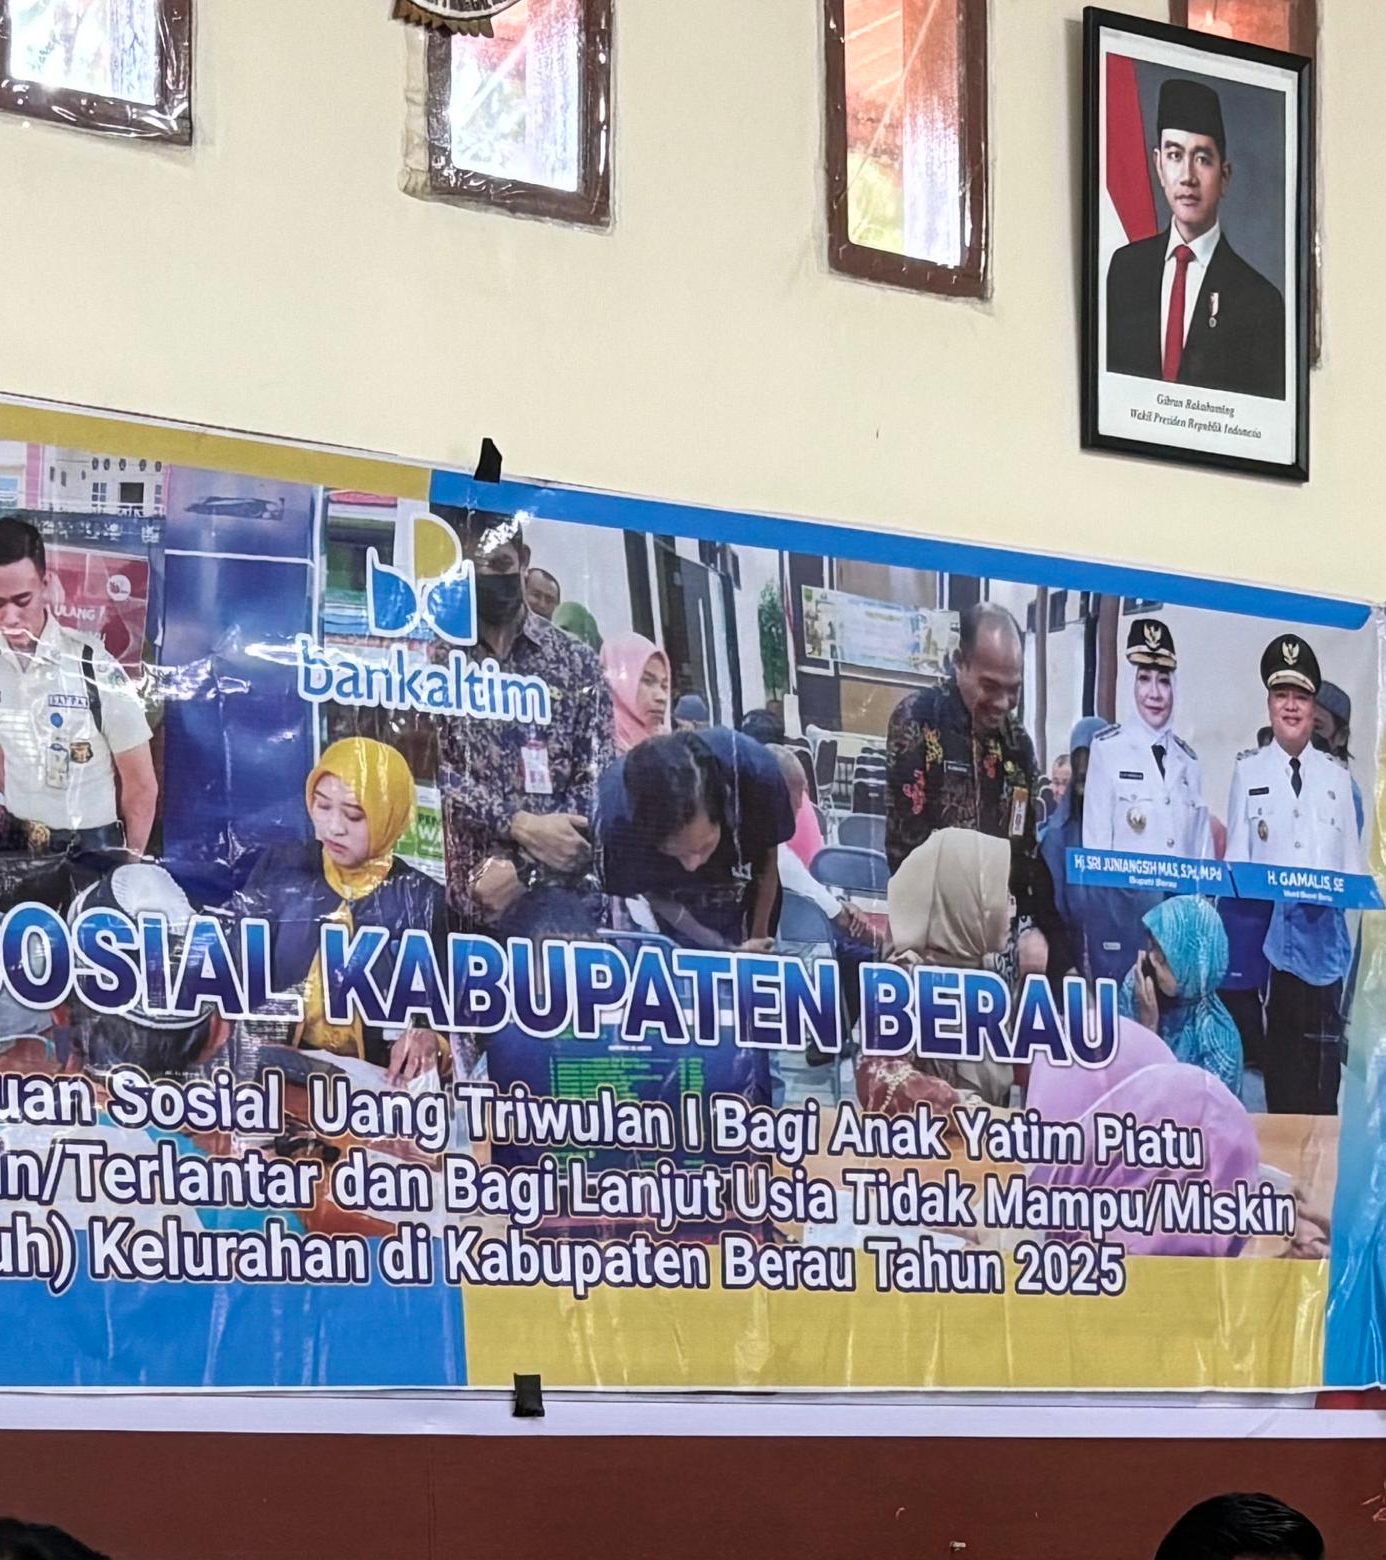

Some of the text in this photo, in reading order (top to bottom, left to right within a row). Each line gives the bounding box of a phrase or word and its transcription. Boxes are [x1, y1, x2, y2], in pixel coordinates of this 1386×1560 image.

[297, 634, 550, 723] bankaltim
[320, 922, 842, 1054] KABUPATEN
[860, 962, 1120, 1070] BERAU
[109, 1064, 281, 1131] Sosial
[313, 1076, 446, 1148] Uang
[457, 1085, 672, 1146] Triwulan
[685, 1096, 700, 1149] I
[714, 1096, 819, 1163] Bagi
[830, 1104, 946, 1160] Anak
[954, 1110, 1083, 1165] Yatim
[1095, 1114, 1203, 1169] Piatu
[335, 1151, 431, 1210] dan
[444, 1158, 556, 1224] Bagi
[571, 1161, 722, 1228] Lanjut
[732, 1167, 837, 1222] Usia
[844, 1172, 976, 1226] Tidak
[986, 1176, 1297, 1239] Mampu/Miskin
[90, 1220, 368, 1282] Kelurahan
[380, 1225, 433, 1284] di
[446, 1227, 709, 1297] Kabupaten
[723, 1234, 854, 1289] Berau
[865, 1239, 1004, 1292] Tahun
[1016, 1242, 1125, 1294] 2025
